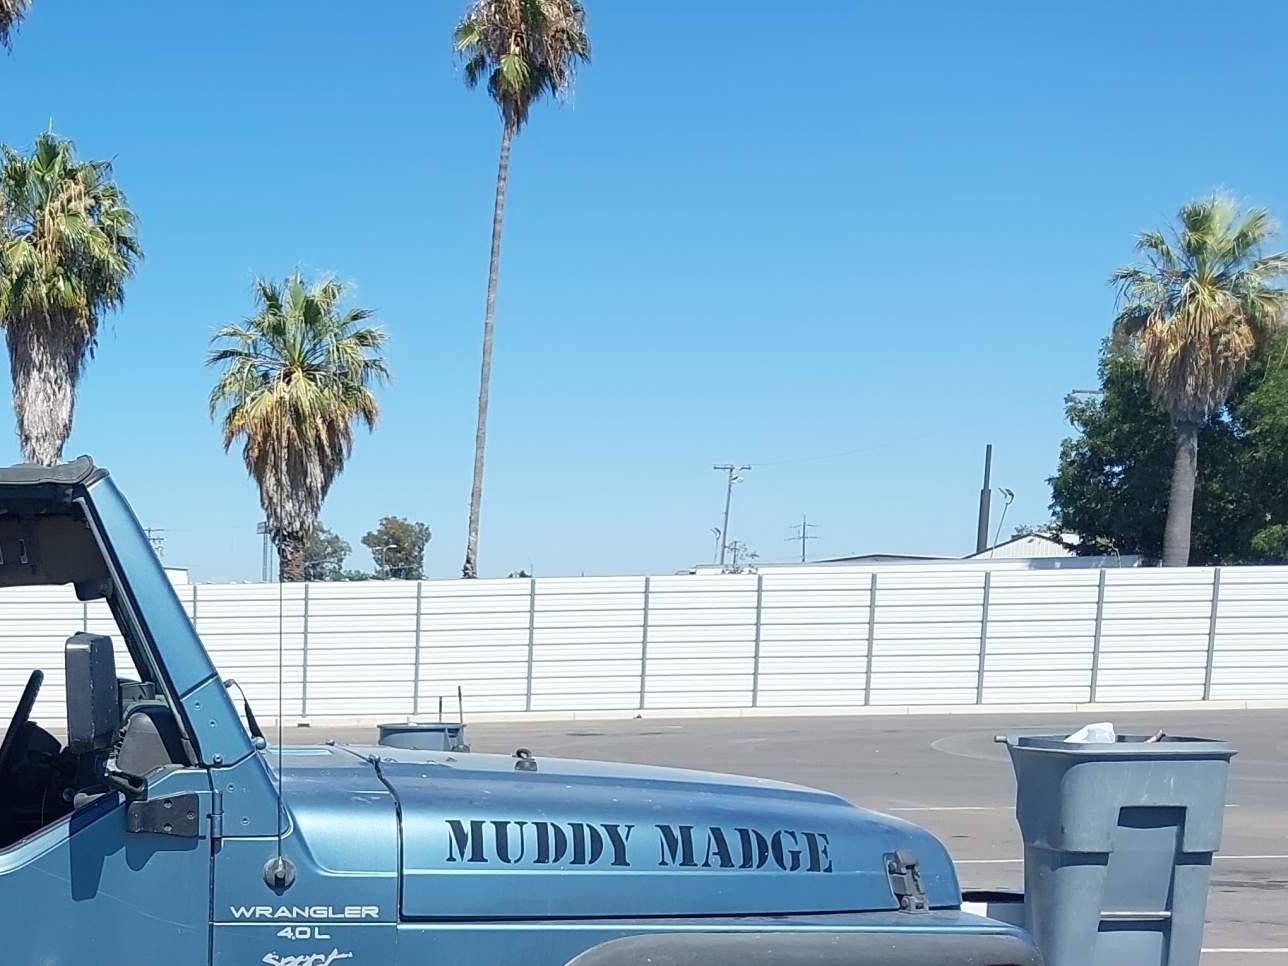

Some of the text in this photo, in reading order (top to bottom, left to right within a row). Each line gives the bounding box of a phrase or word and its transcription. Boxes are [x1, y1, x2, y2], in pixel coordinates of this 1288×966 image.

[445, 820, 833, 873] MUDDY MADGE
[230, 906, 379, 919] WRANGLER
